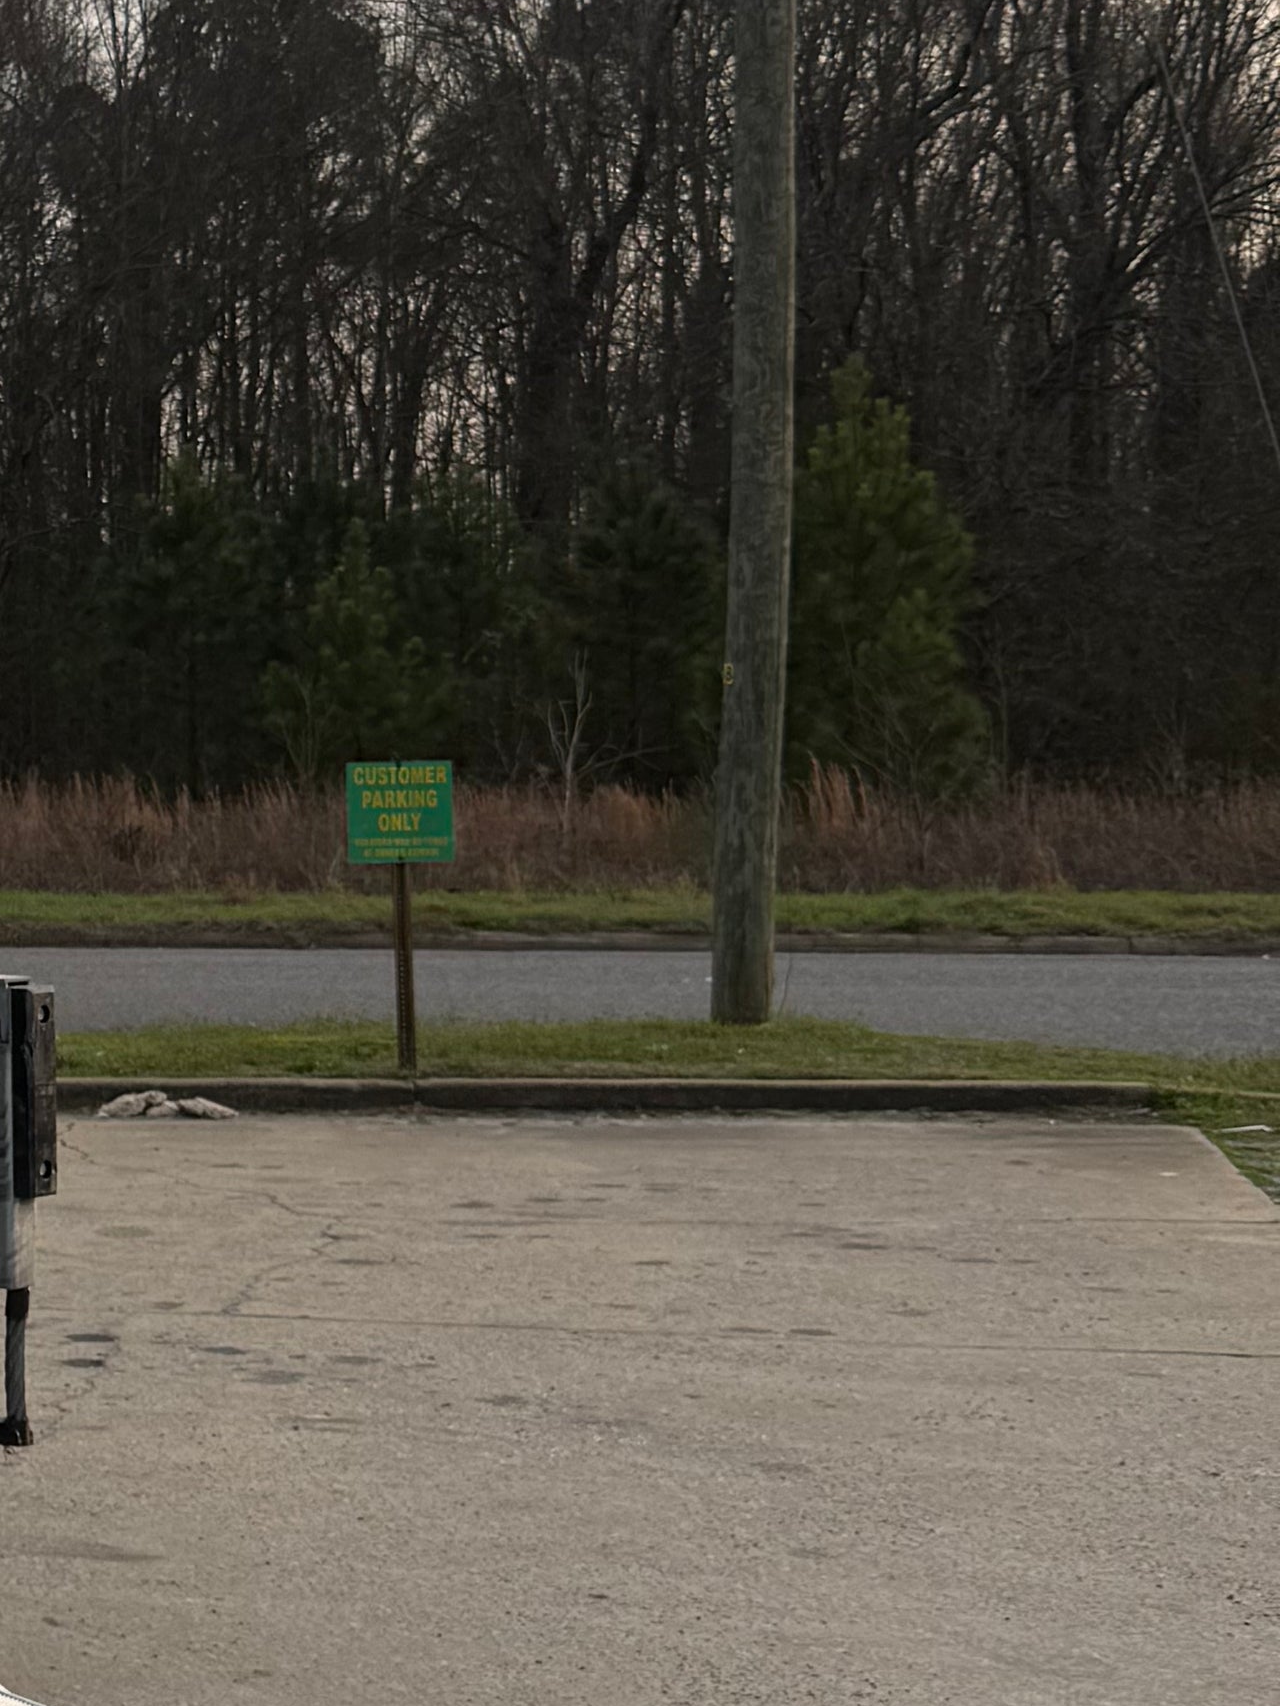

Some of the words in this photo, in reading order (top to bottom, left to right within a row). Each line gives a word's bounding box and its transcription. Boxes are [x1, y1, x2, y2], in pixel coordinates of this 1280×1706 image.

[353, 766, 447, 785] CUSTOMER
[362, 789, 438, 809] PARKING
[377, 812, 422, 832] ONLY
